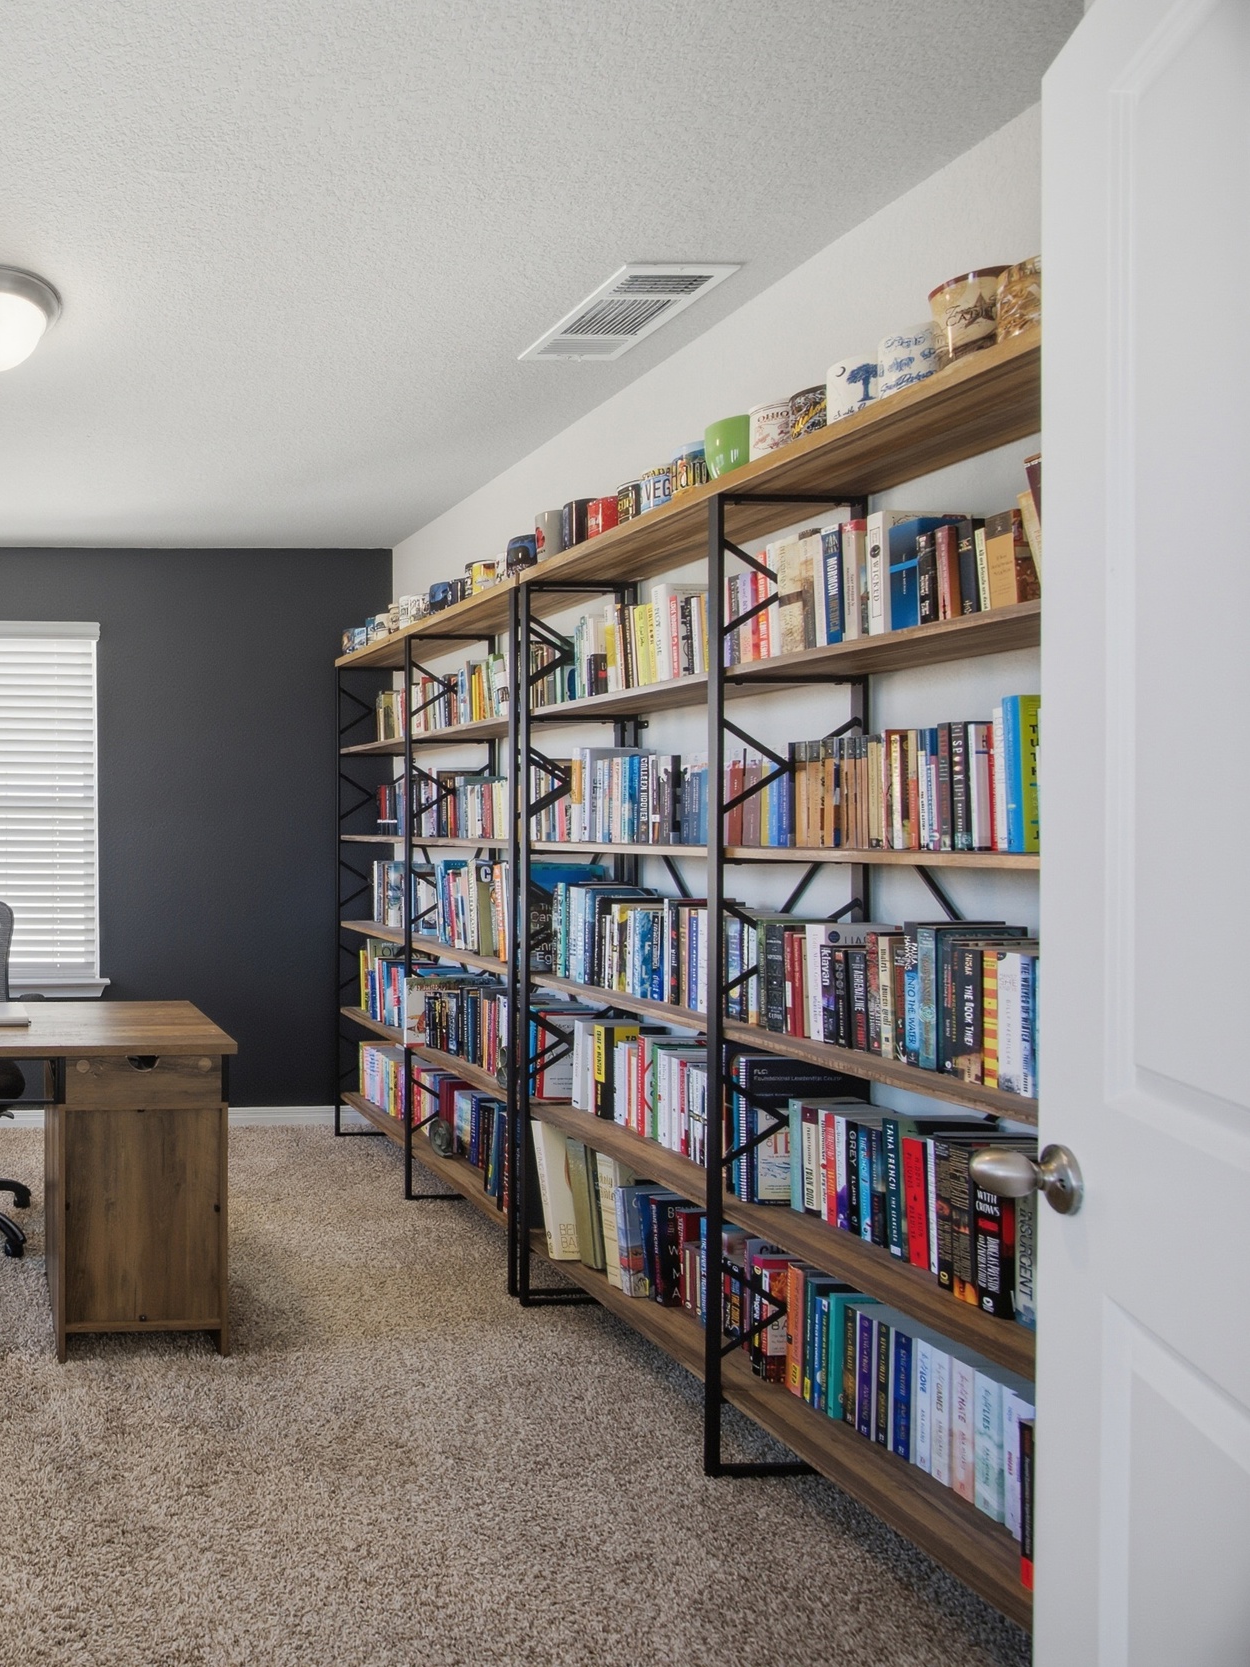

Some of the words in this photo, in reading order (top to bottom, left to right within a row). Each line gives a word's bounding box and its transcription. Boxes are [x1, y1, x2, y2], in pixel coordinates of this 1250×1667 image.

[757, 410, 790, 423] OHIO
[644, 477, 671, 501] VEG
[827, 556, 839, 596] MORMON
[872, 560, 880, 602] WICKED
[760, 622, 768, 638] EMILY
[640, 758, 648, 790] COLLEEN
[640, 792, 648, 822] HOOVER
[904, 936, 912, 970] HAWKINS
[821, 950, 832, 986] klavan
[1021, 962, 1030, 974] THE
[853, 970, 865, 1011] ADRENALINE
[907, 974, 916, 998] INTO
[964, 985, 974, 1000] THE
[908, 1000, 916, 1014] THE
[964, 1002, 975, 1022] BOOK
[908, 1017, 916, 1045] WATER
[964, 1026, 974, 1046] THIEF
[1021, 1017, 1032, 1042] WINTER
[886, 1124, 895, 1149] TANA
[806, 1168, 814, 1186] IVAN
[888, 1152, 896, 1190] FRENCH
[806, 1188, 815, 1207] DOIG
[950, 1180, 970, 1210] DEATH
[987, 1236, 1000, 1265] DOUGLAS
[1019, 1208, 1034, 1300] INSURGENT
[732, 1306, 740, 1327] CODEX
[920, 1370, 928, 1393] LOVE
[936, 1382, 944, 1413] GAMES
[958, 1397, 966, 1423] HATE
[982, 1409, 990, 1430] LIES
